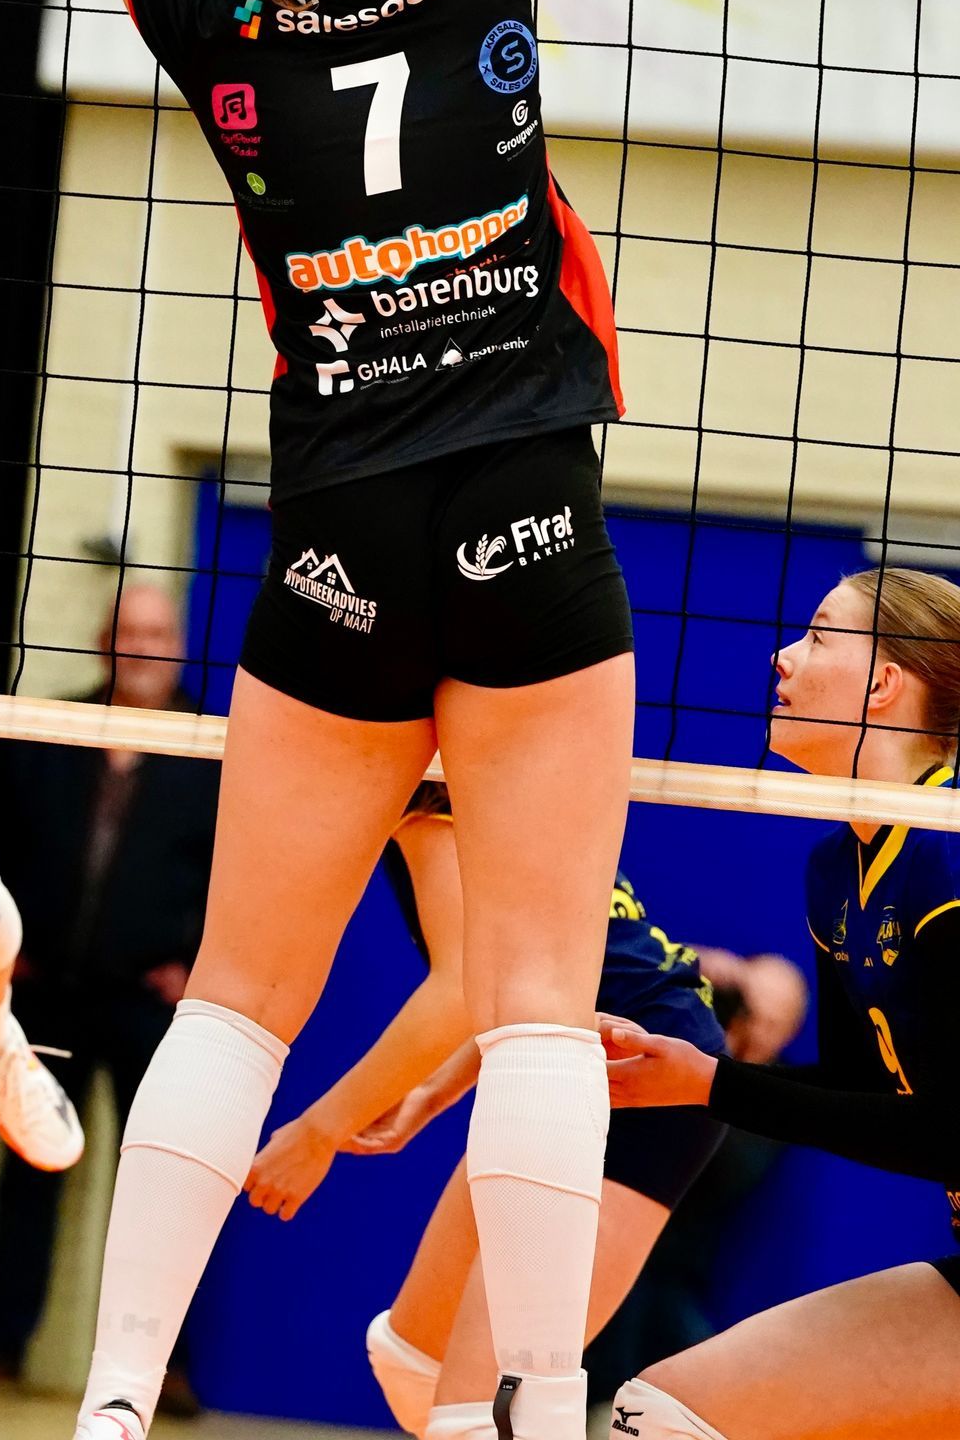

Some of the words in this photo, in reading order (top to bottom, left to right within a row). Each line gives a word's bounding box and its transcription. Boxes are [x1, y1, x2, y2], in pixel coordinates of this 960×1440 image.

[484, 30, 499, 50] KPI
[496, 22, 524, 35] SALES
[490, 77, 521, 91] SALES
[330, 51, 411, 197] 7
[287, 195, 529, 292] autohopper
[371, 264, 539, 317] batenburg
[380, 306, 496, 339] installatietechniek
[357, 353, 427, 381] GHALA
[510, 506, 574, 553] Firat
[519, 537, 576, 566] BAKERY
[283, 568, 377, 618] HYPOTHEEKADVIES
[329, 607, 344, 622] OP
[343, 613, 375, 634] MAAT
